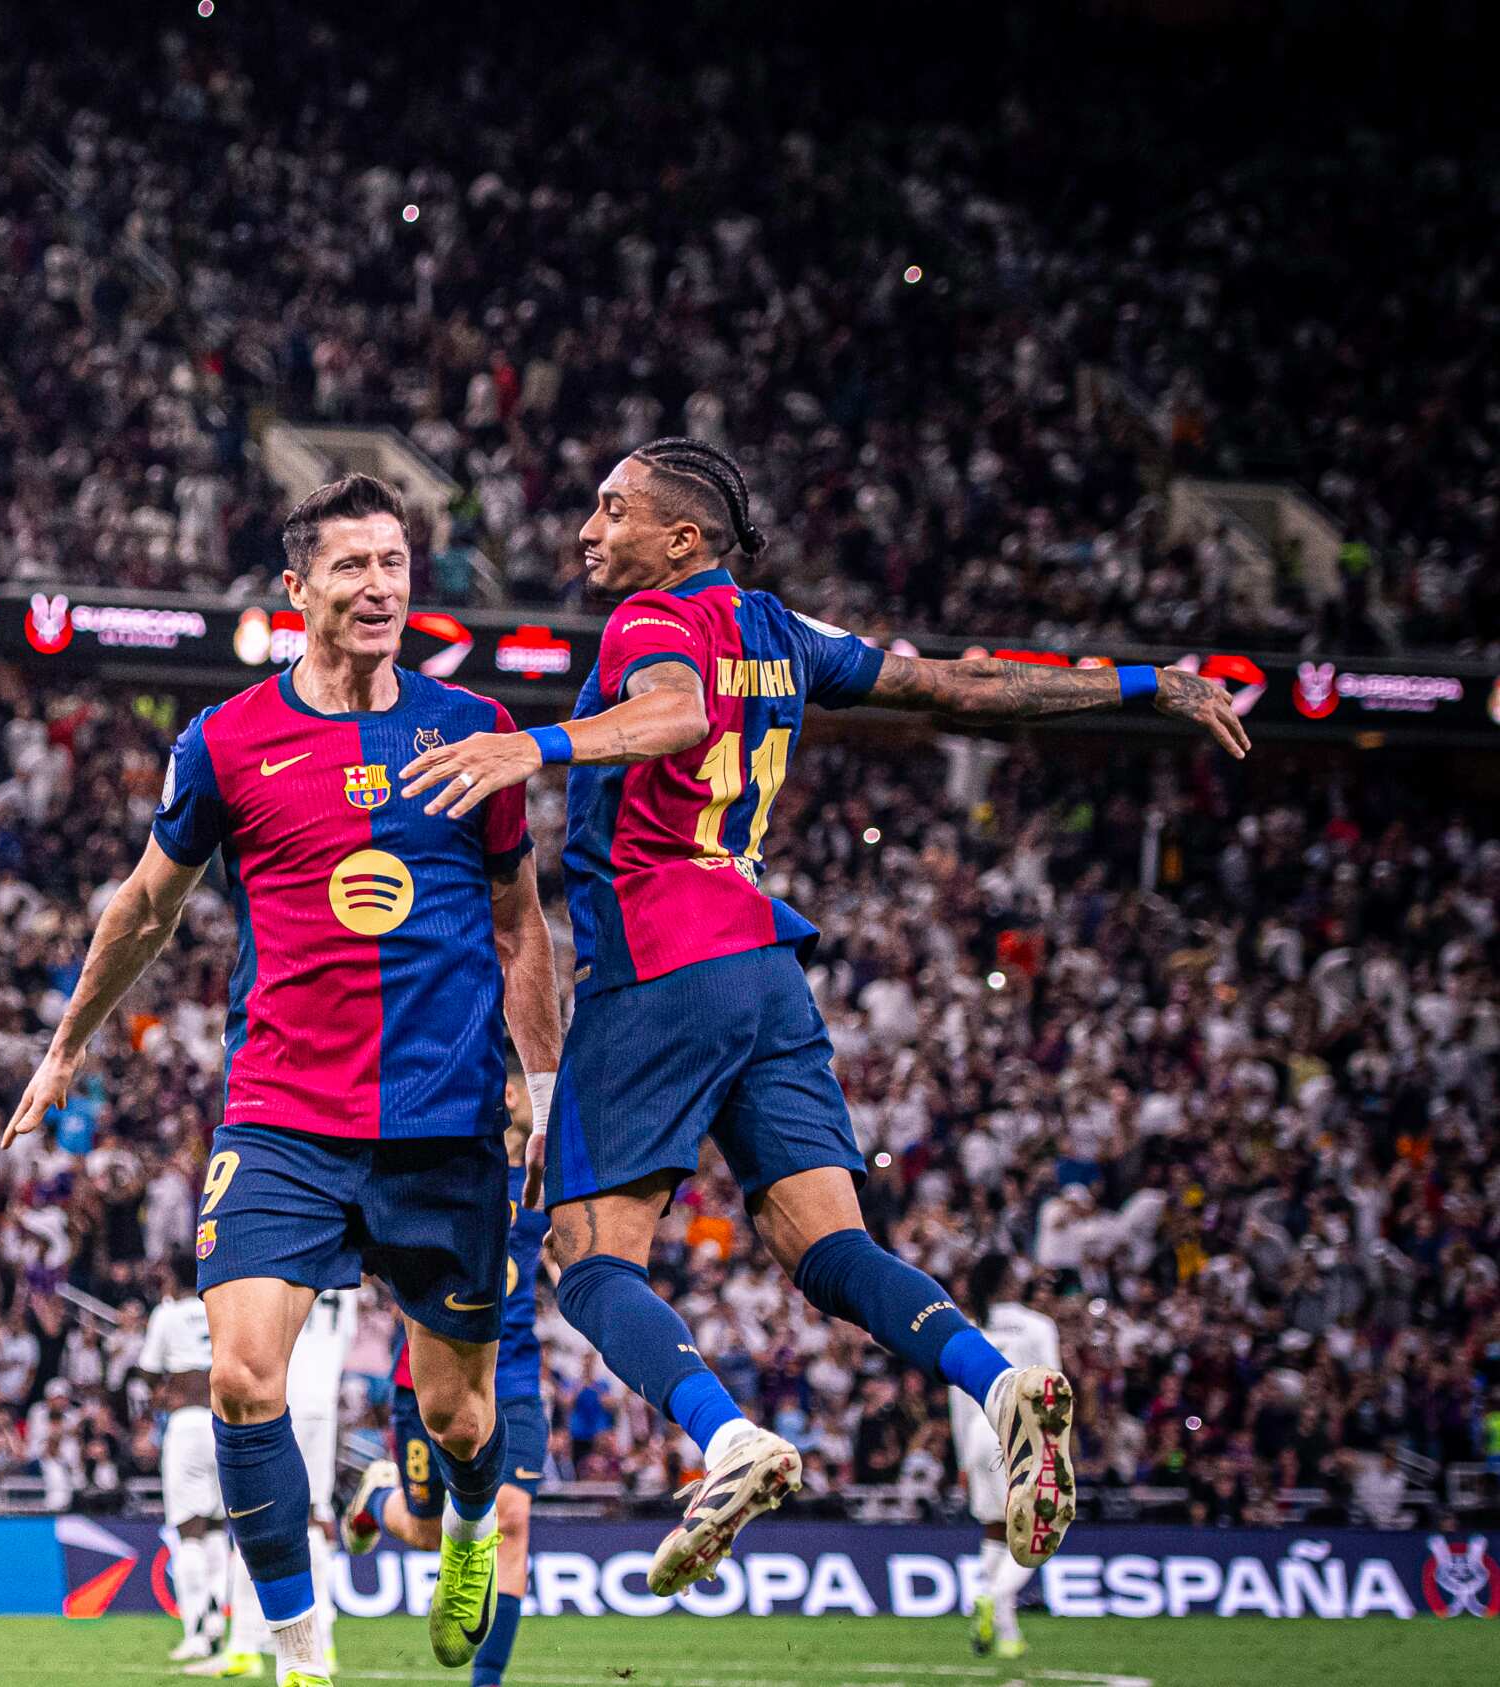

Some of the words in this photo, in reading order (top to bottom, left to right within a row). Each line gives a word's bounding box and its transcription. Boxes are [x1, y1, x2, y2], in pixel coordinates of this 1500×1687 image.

[695, 728, 791, 861] 11
[201, 1150, 241, 1215] 9
[406, 1439, 430, 1483] 8
[1042, 1540, 1417, 1618] ESPAÑA
